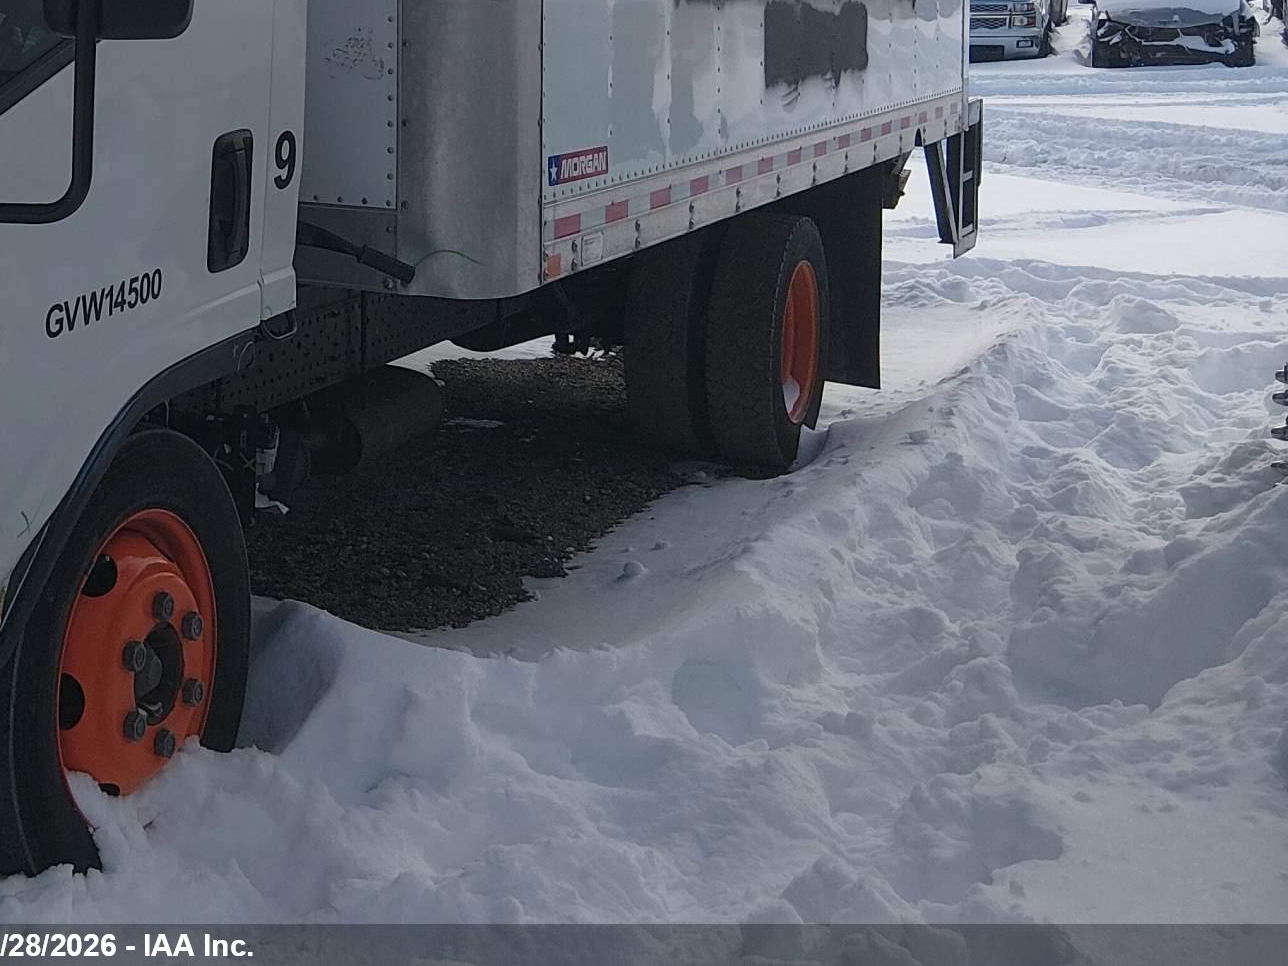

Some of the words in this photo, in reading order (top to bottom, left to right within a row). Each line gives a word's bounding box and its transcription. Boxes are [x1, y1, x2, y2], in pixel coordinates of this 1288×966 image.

[273, 130, 297, 190] 9
[560, 151, 607, 180] MORGAN
[45, 268, 162, 339] GVW14500
